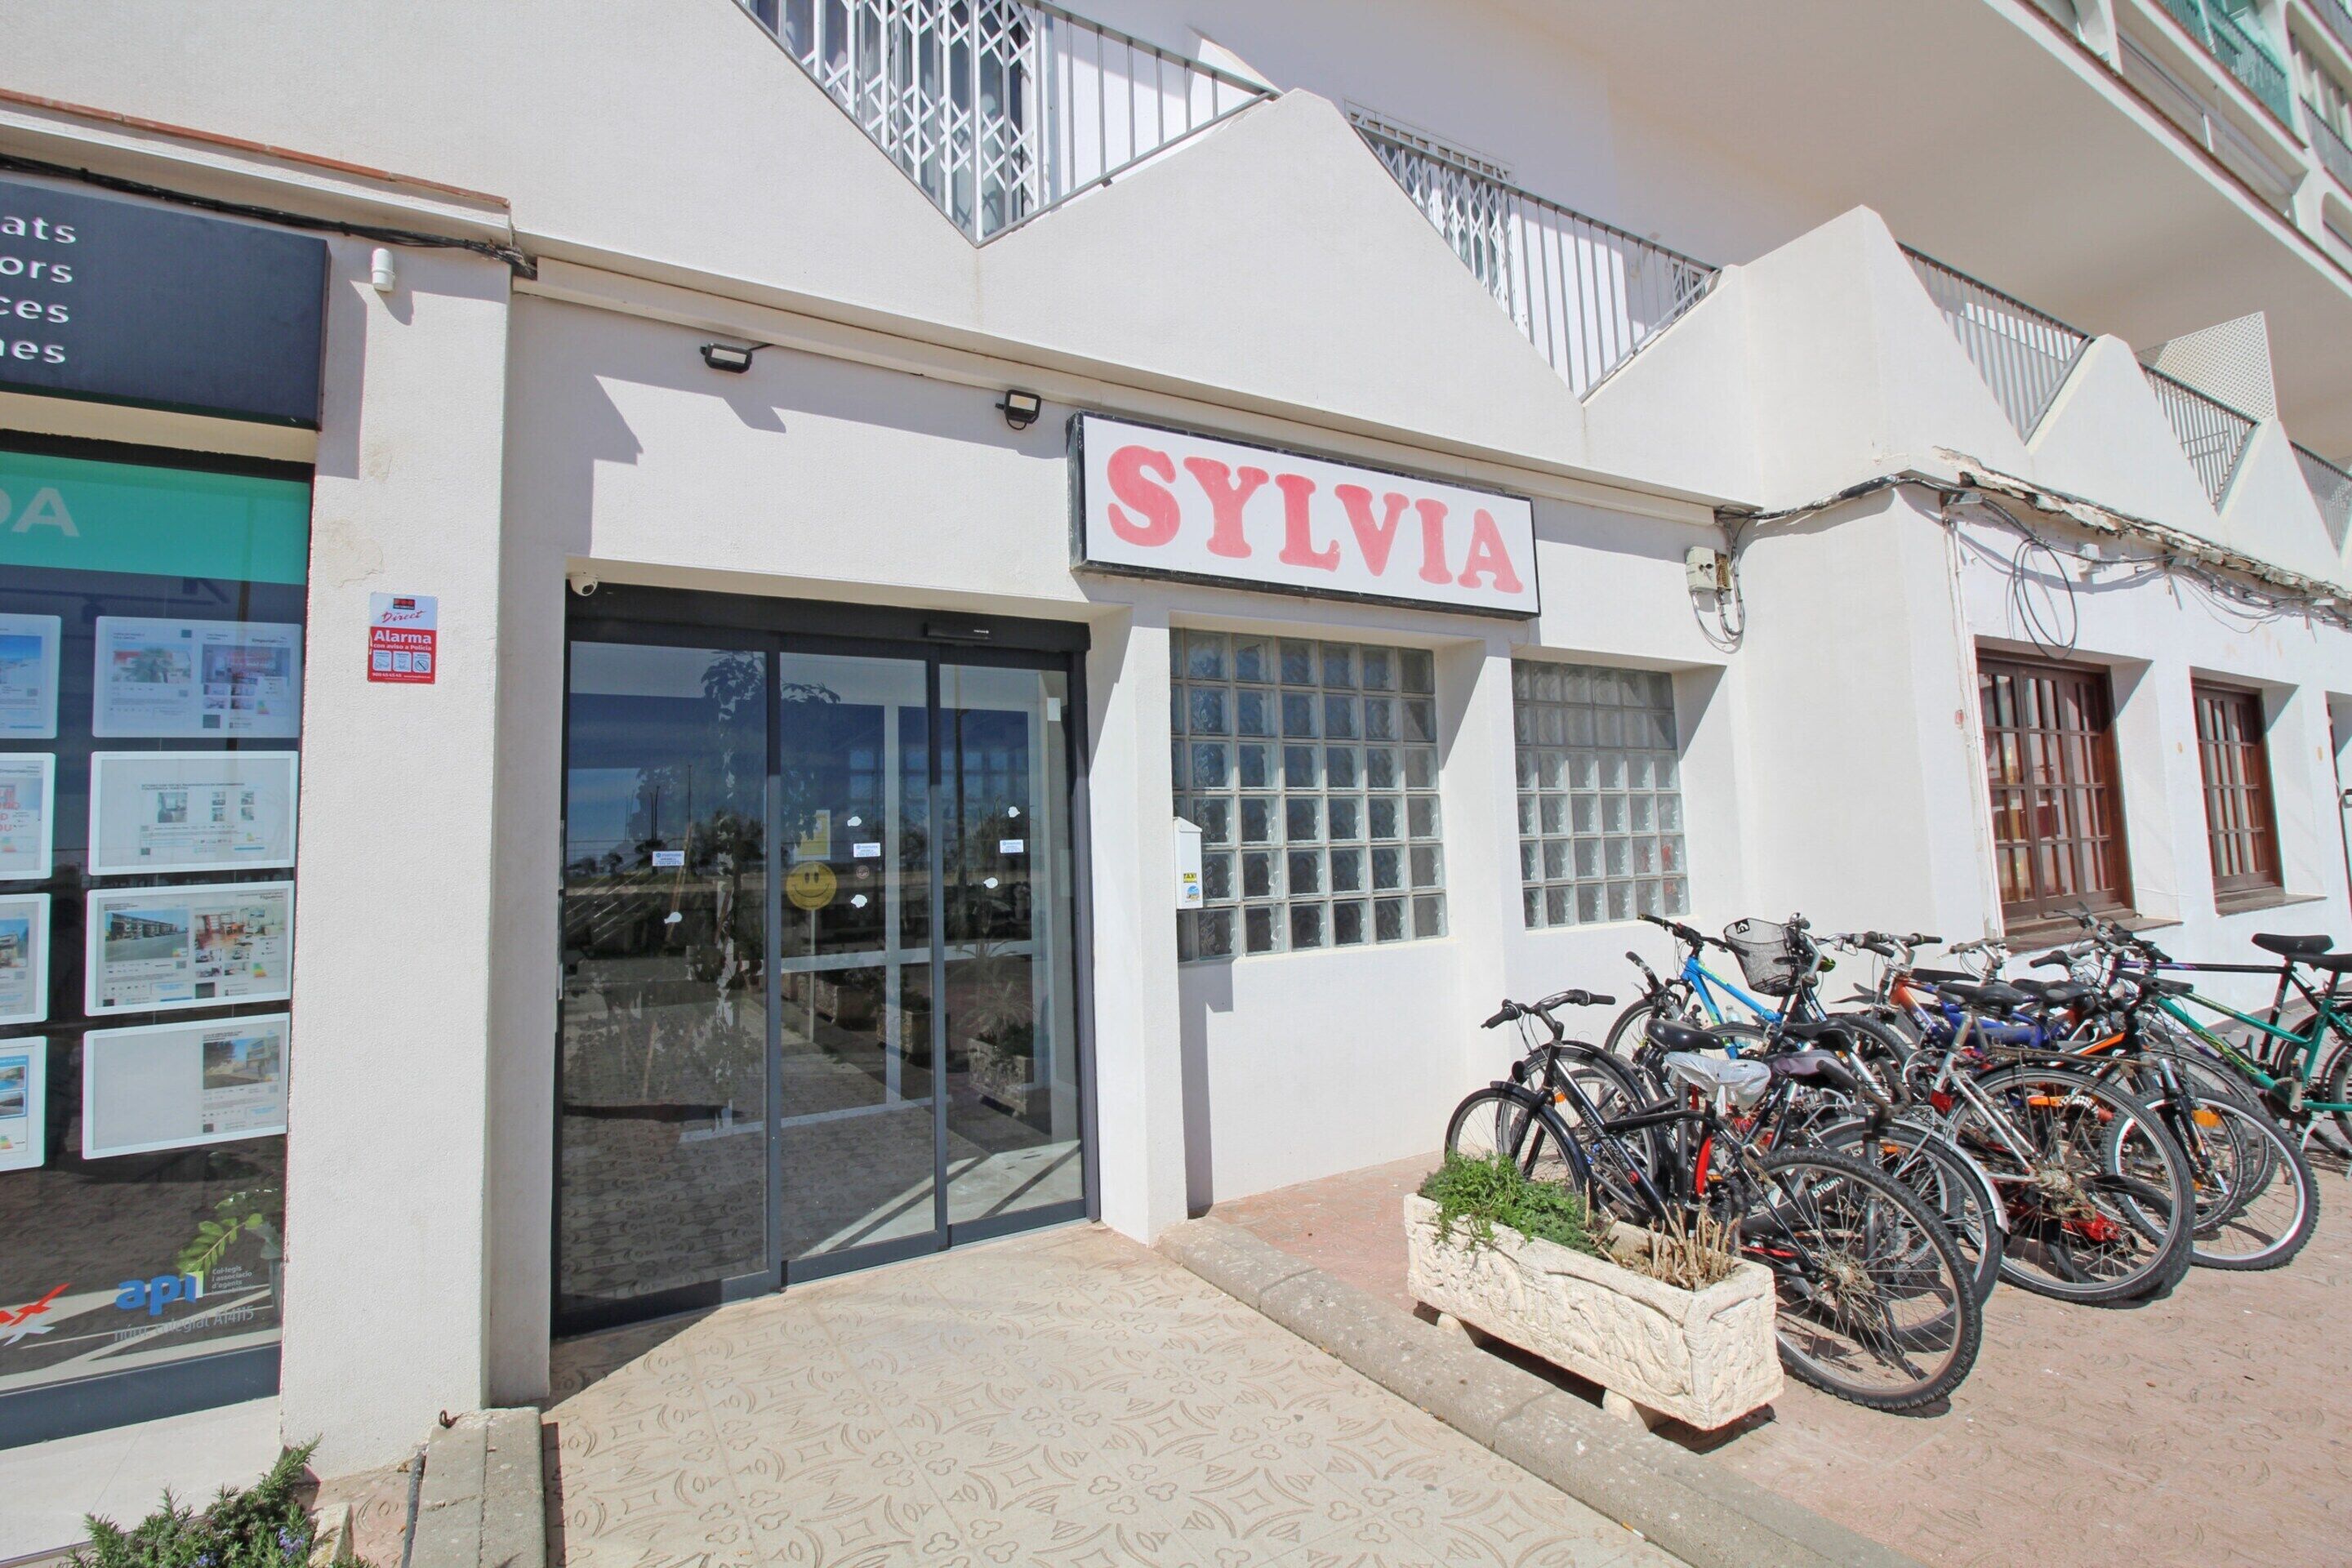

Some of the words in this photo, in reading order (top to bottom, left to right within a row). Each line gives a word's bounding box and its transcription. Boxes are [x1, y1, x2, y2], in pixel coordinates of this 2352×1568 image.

[0, 338, 65, 364] es
[1107, 444, 1524, 594] SYLVIA
[381, 611, 426, 623] Direct
[373, 630, 432, 644] Alarma
[115, 1271, 204, 1316] api
